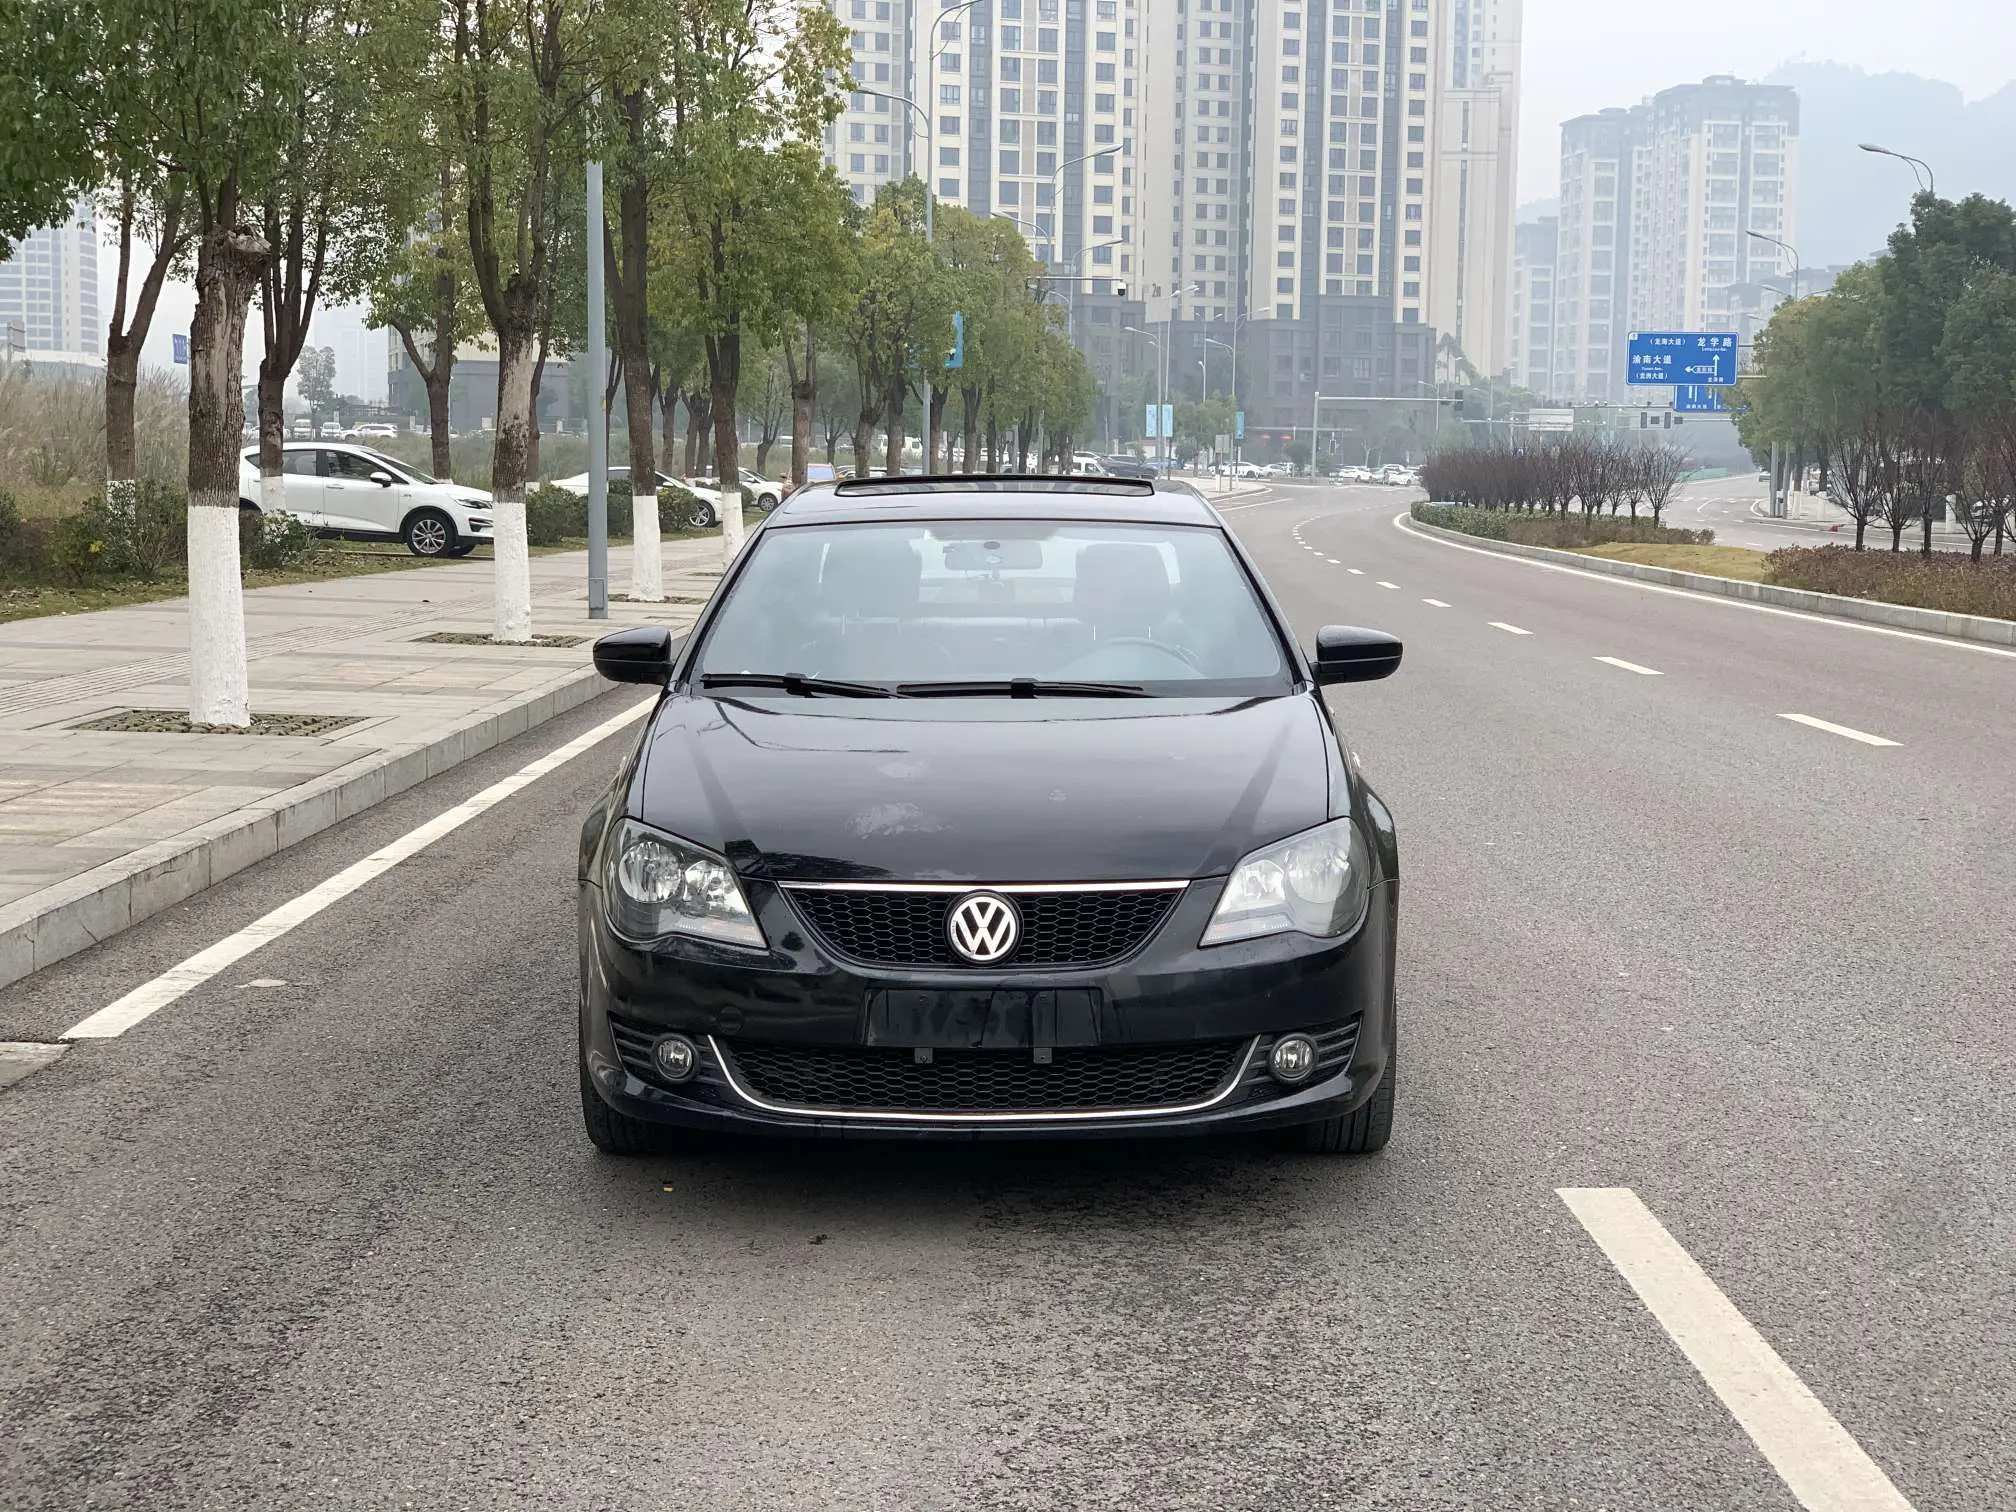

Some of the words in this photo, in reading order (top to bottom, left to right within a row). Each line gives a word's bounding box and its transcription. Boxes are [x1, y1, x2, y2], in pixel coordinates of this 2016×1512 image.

[1632, 354, 1672, 364] 渝南大道
[953, 898, 1014, 959] VW
